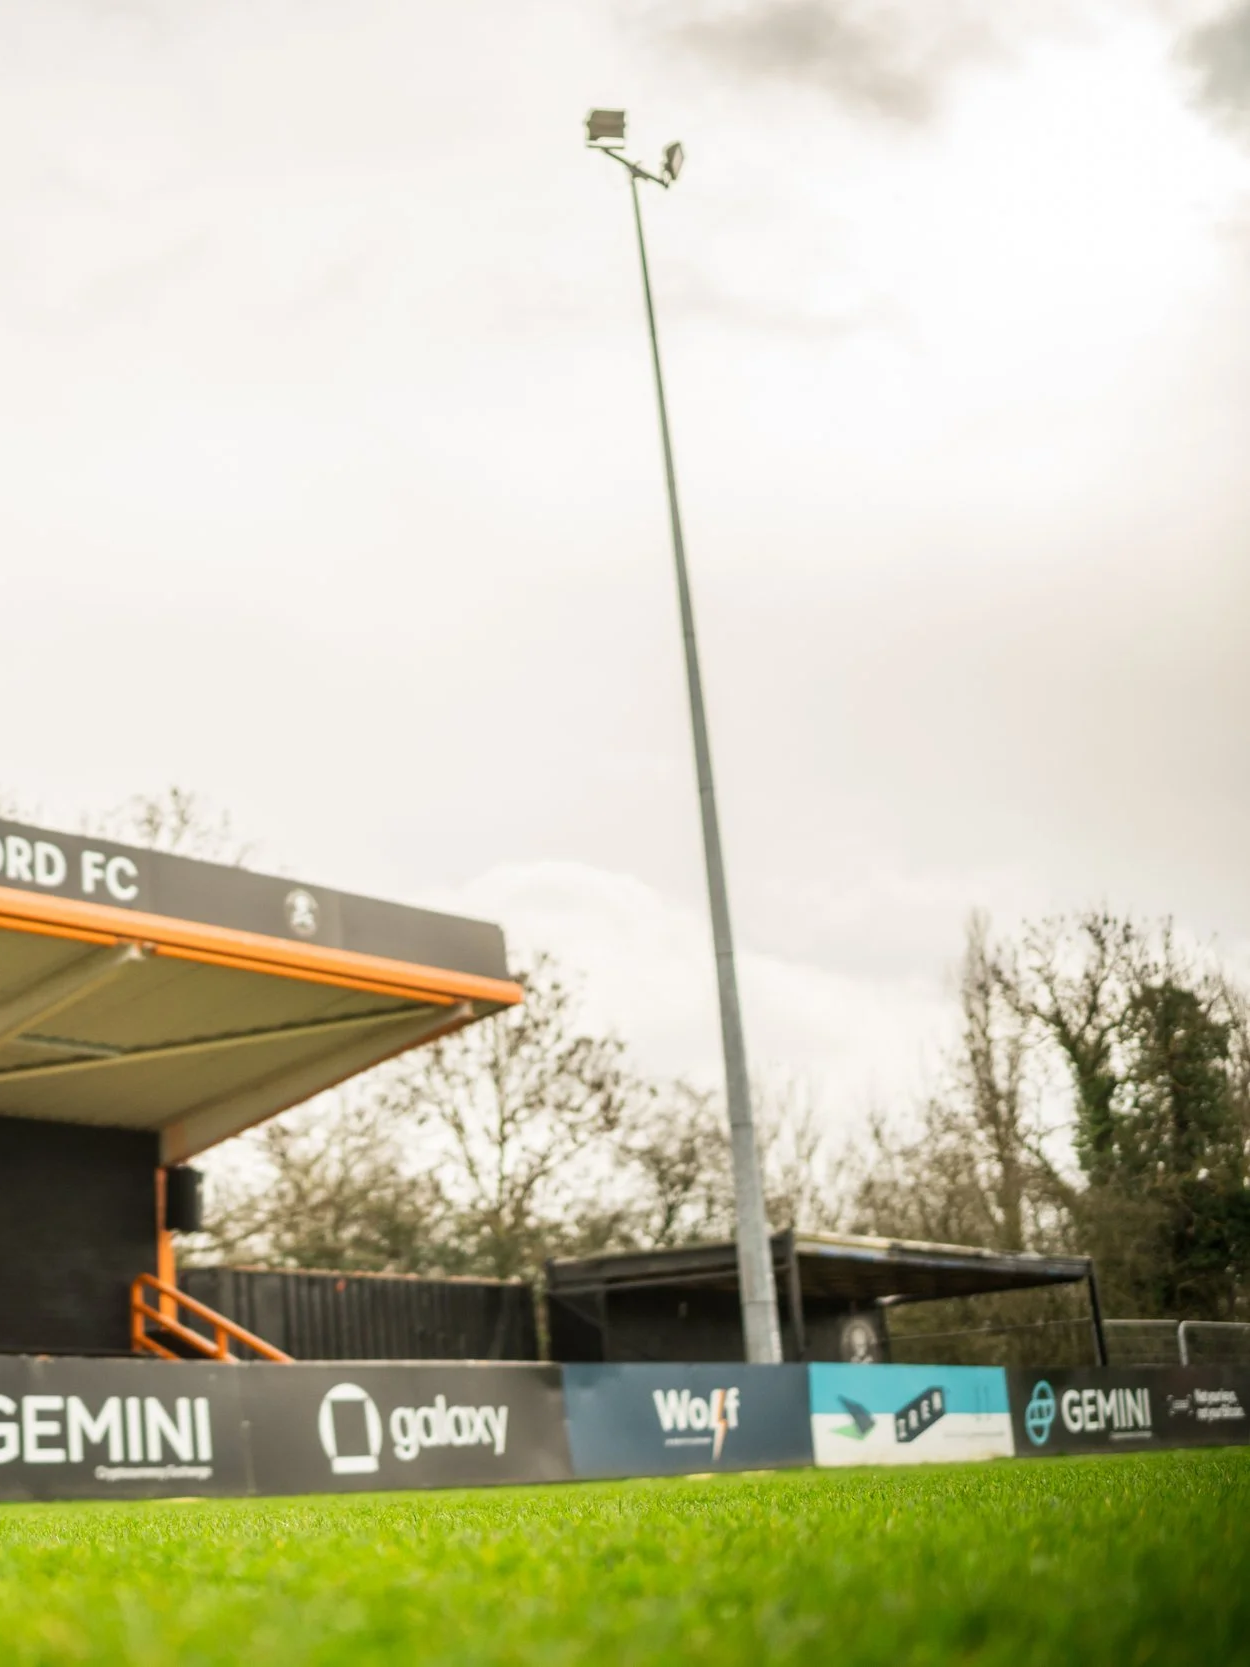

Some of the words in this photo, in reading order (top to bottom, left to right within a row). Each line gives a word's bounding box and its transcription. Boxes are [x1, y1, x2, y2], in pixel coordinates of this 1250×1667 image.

[81, 849, 139, 901] FC
[389, 1393, 509, 1461] galaxy
[652, 1387, 740, 1432] Wolf
[1061, 1388, 1152, 1433] GEMINI
